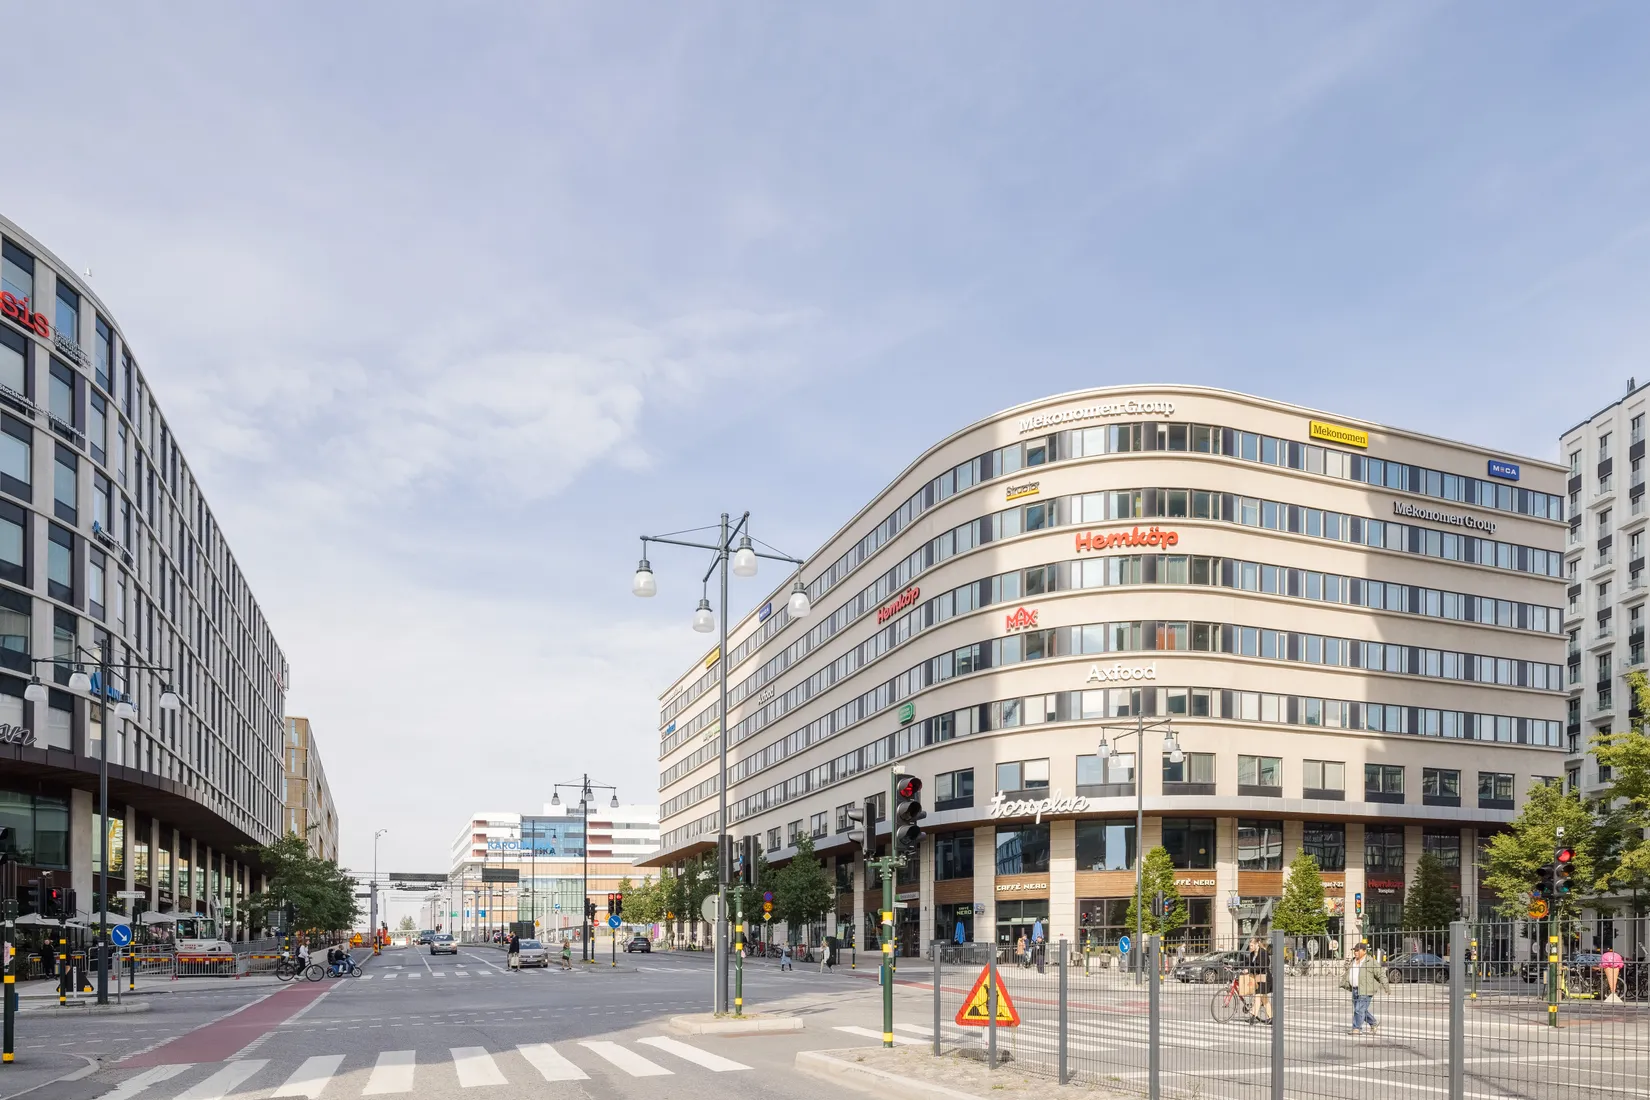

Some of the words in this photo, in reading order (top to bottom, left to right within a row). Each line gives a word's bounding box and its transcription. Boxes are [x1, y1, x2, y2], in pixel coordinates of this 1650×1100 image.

[1018, 403, 1123, 434] Mekonomen
[1124, 399, 1176, 417] Group
[1313, 424, 1366, 444] Mekonomen
[1394, 500, 1463, 526] Mekonomen
[1464, 515, 1497, 534] Group
[1076, 526, 1179, 552] Hemköp
[877, 586, 920, 624] Hemköp
[1006, 607, 1038, 631] MAX
[1087, 662, 1157, 683] Axfood
[1173, 878, 1191, 886] FFÈ
